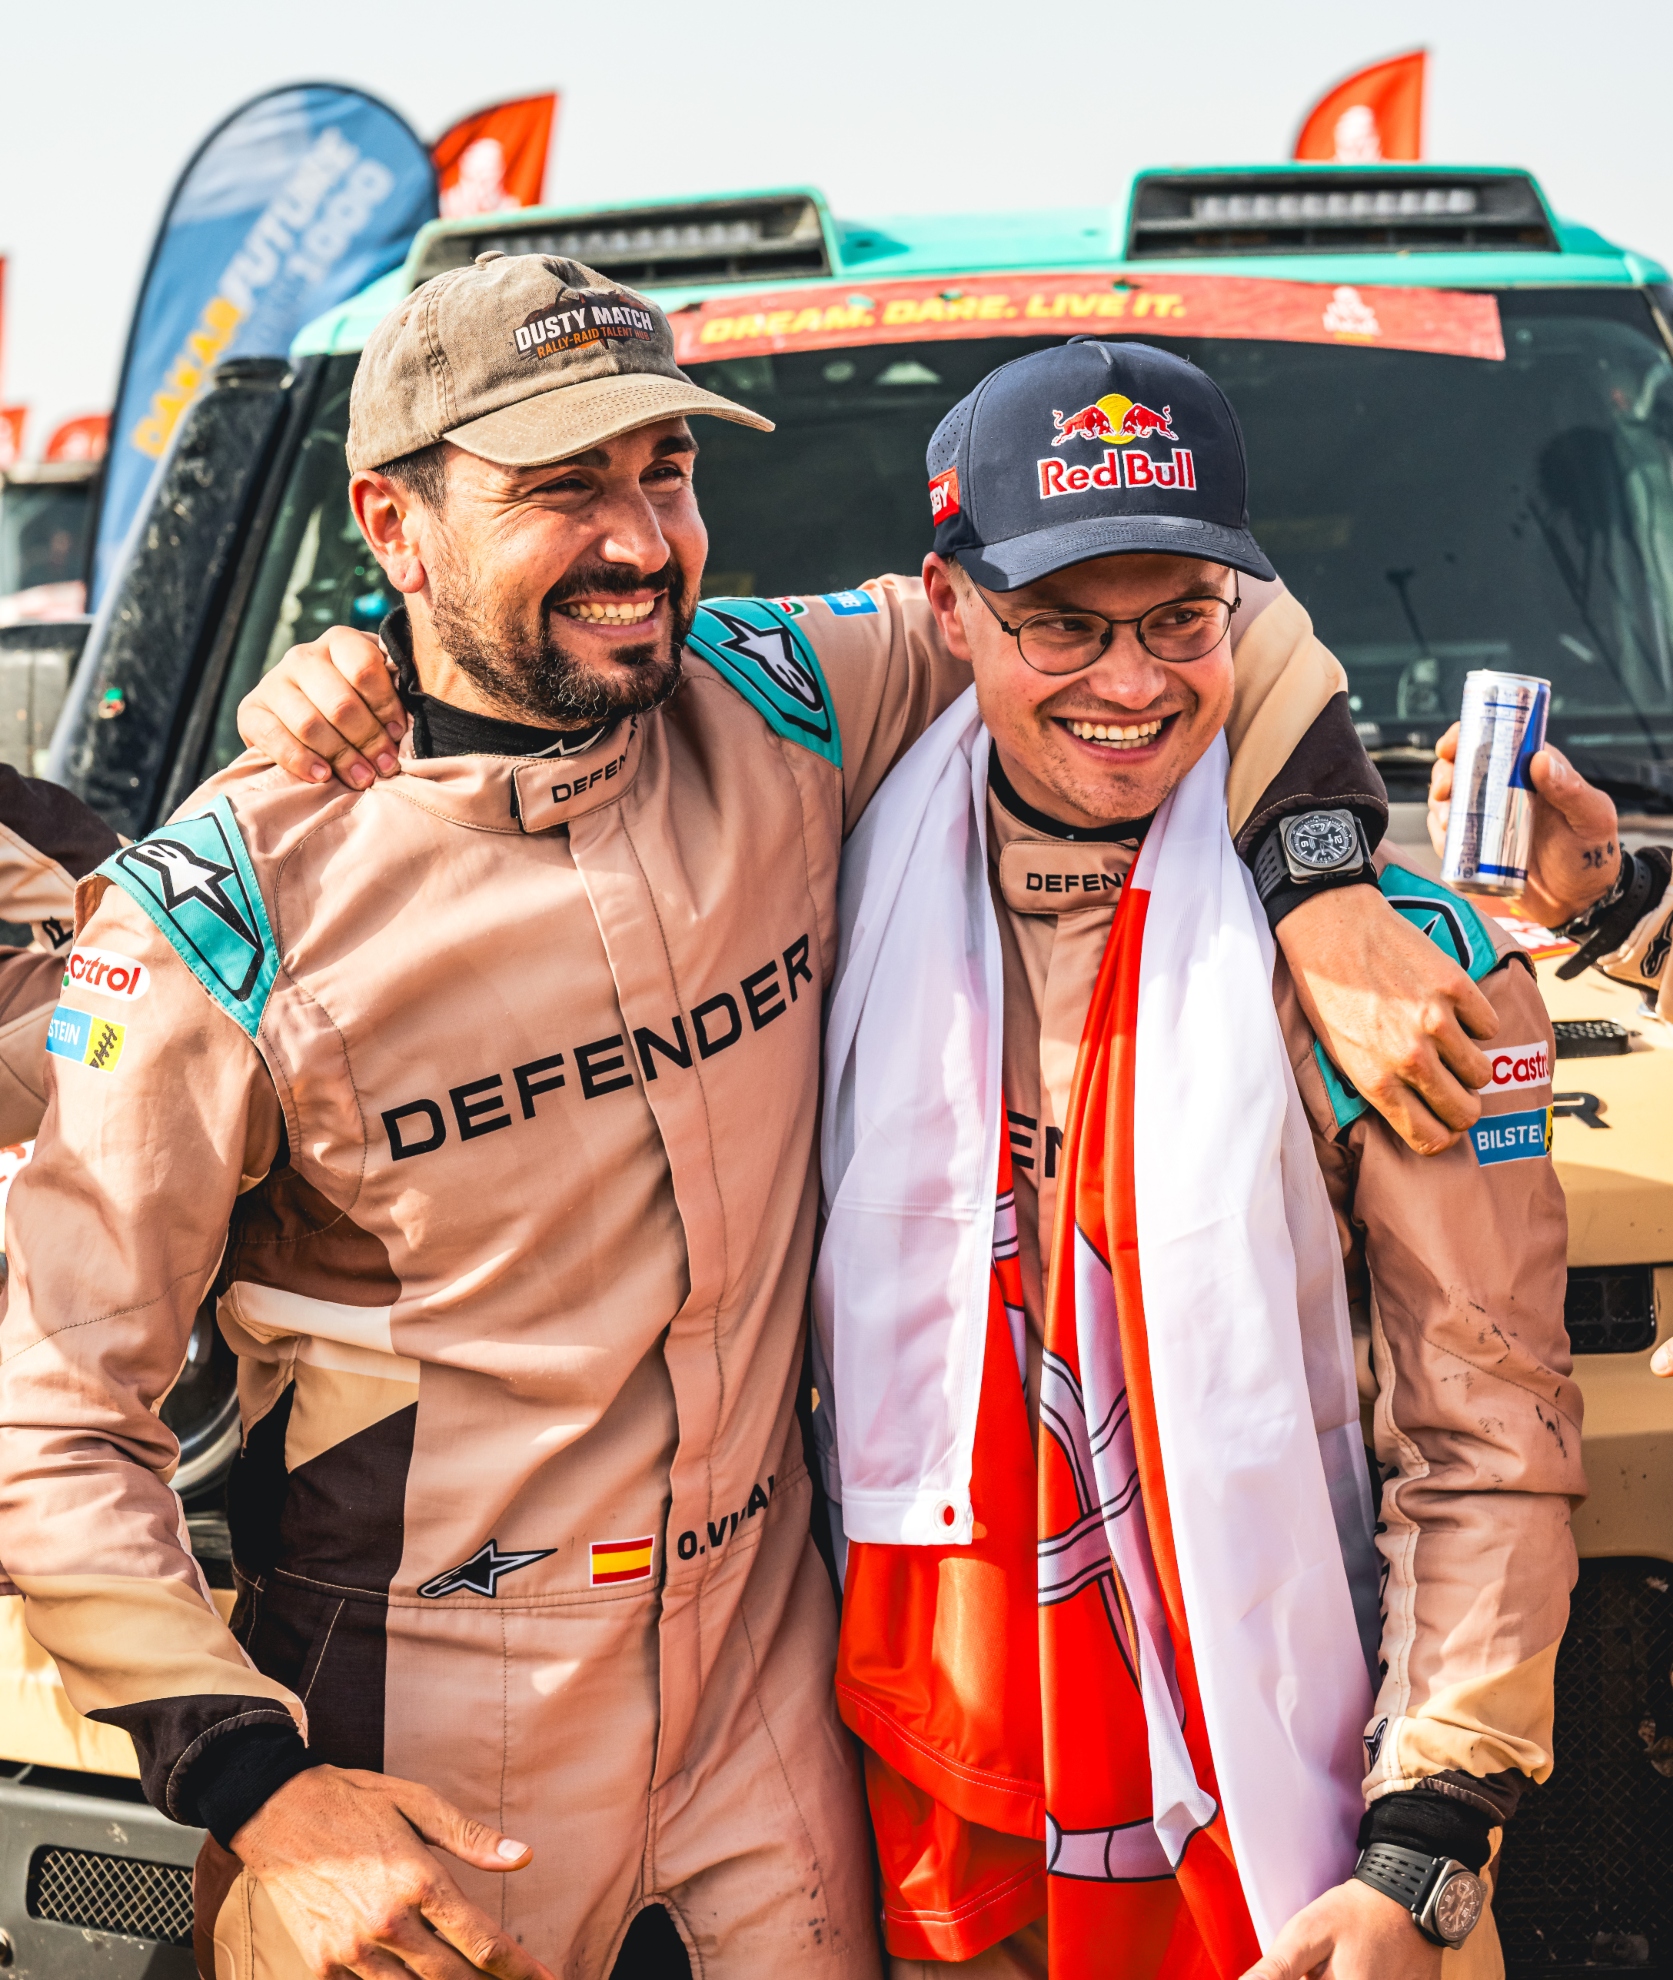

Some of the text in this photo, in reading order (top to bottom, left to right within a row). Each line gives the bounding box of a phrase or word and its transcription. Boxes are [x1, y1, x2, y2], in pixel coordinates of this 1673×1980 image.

[515, 306, 653, 351] DUSTY MATCH
[537, 326, 650, 359] RALLY-RAID TALENT HUB
[700, 293, 1187, 344] DREAM. DARE. LIVE IT.
[1038, 449, 1196, 499] Red Bull
[381, 933, 813, 1161] DEFENDER
